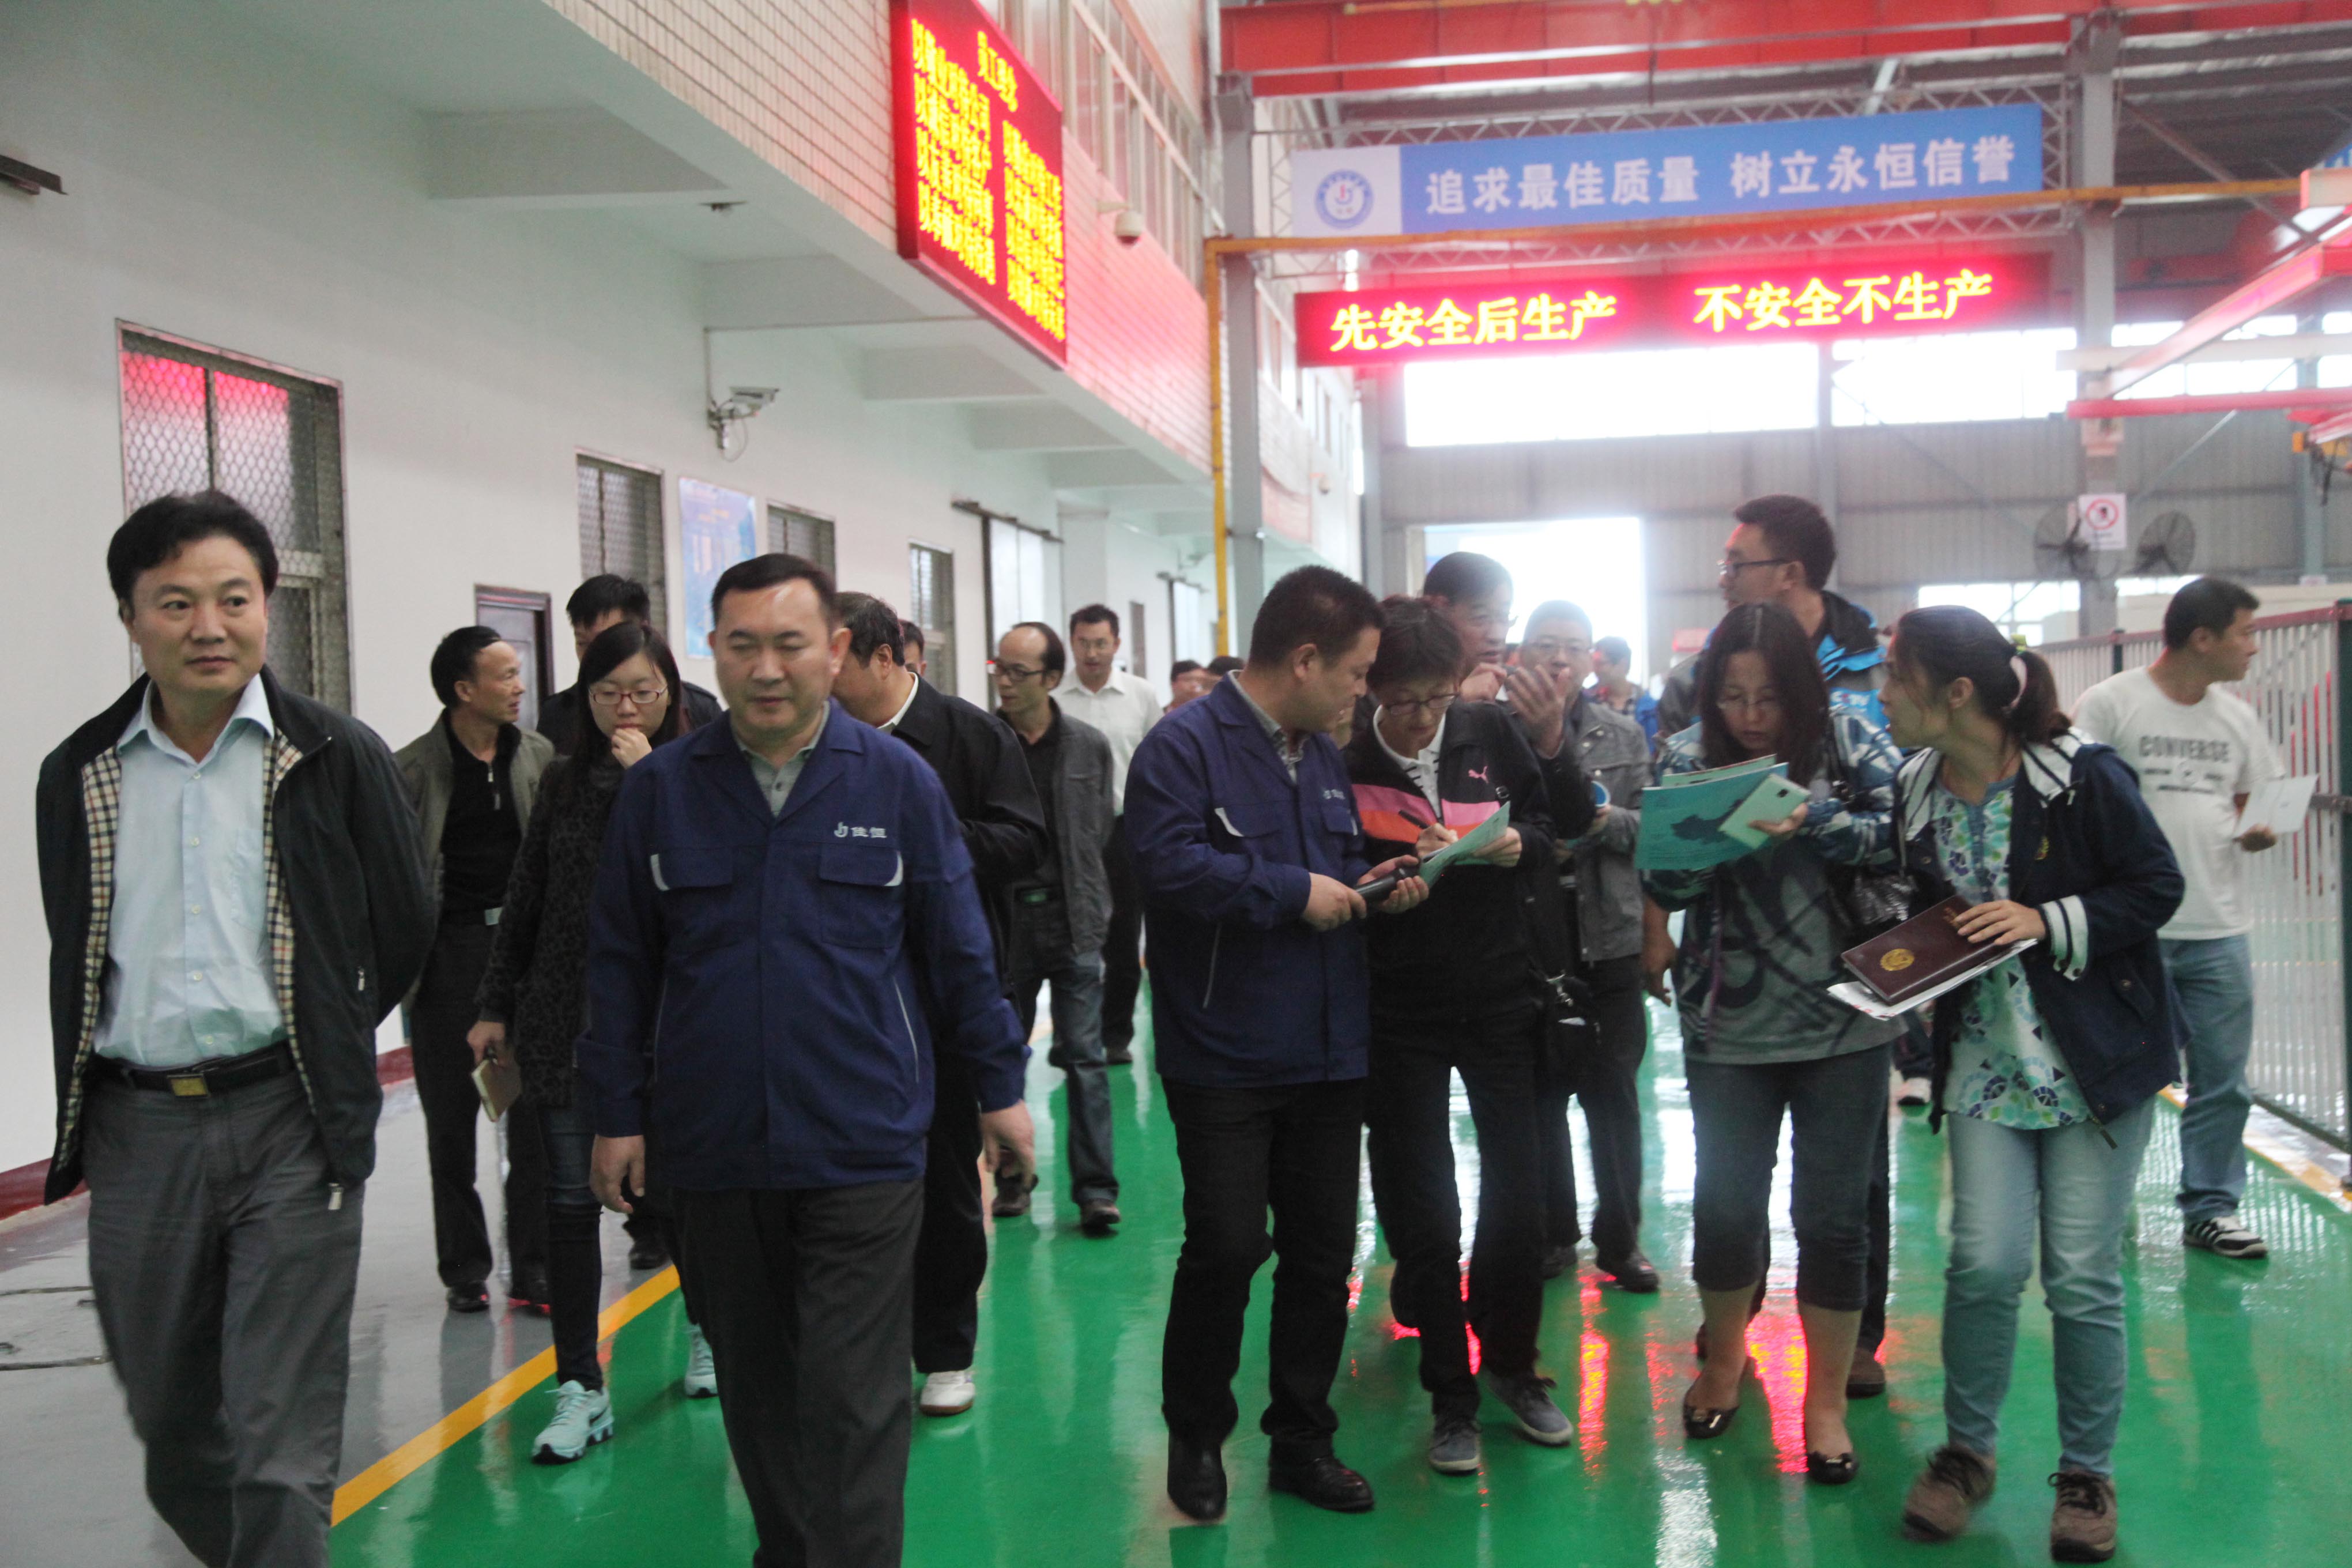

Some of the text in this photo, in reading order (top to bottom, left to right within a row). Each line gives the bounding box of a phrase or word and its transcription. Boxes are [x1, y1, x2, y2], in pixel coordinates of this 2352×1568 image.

[1425, 155, 1699, 215] 追求最佳质量
[1730, 134, 2015, 198] 树立永恒信誉
[1329, 268, 1992, 351] 先安全后生产 不安全不生产
[2139, 735, 2230, 763] CONVERSE
